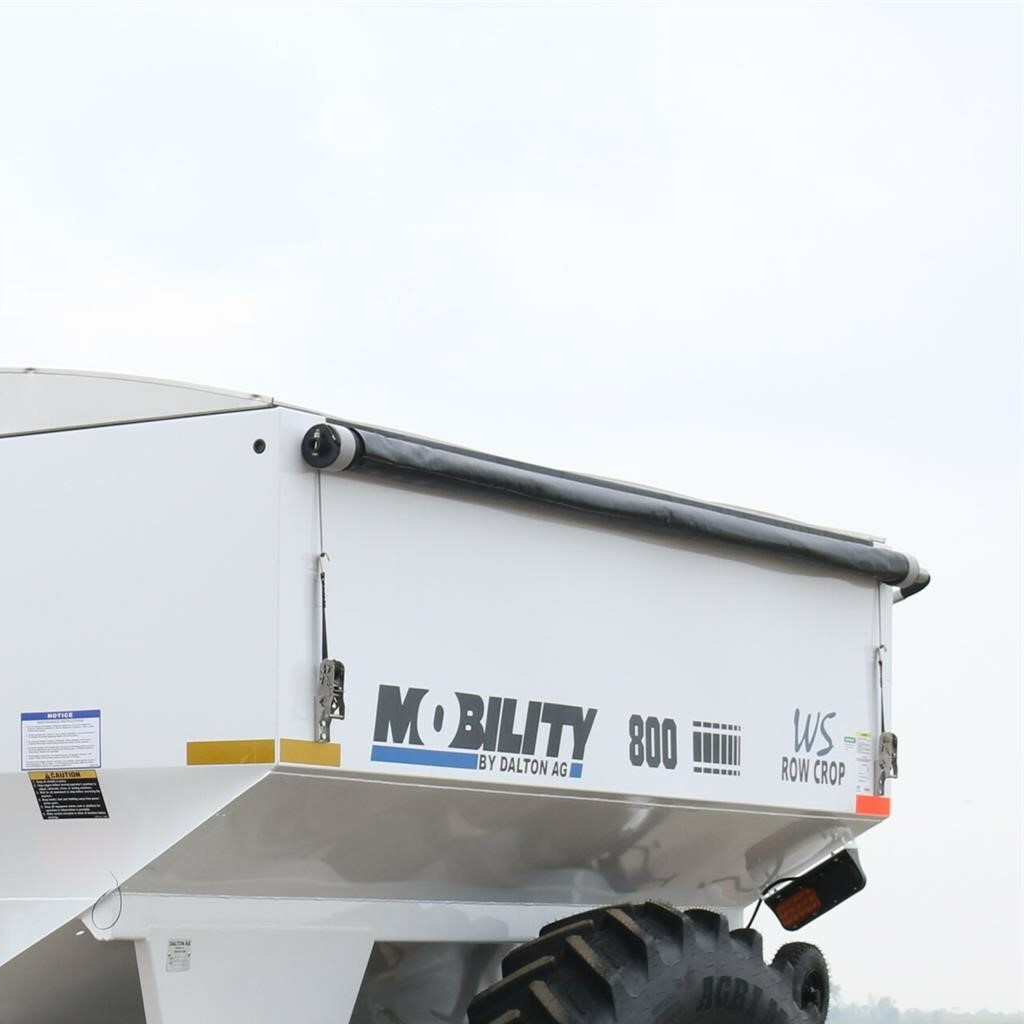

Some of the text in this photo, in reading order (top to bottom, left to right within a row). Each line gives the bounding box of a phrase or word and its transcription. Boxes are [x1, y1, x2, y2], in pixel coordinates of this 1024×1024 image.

[373, 684, 598, 761] MOBILITY
[628, 714, 677, 770] 800
[793, 708, 837, 757] WS
[50, 771, 81, 779] CAUTION
[479, 754, 568, 778] BY DALTON AG
[781, 756, 810, 784] ROW
[813, 760, 846, 787] CROP
